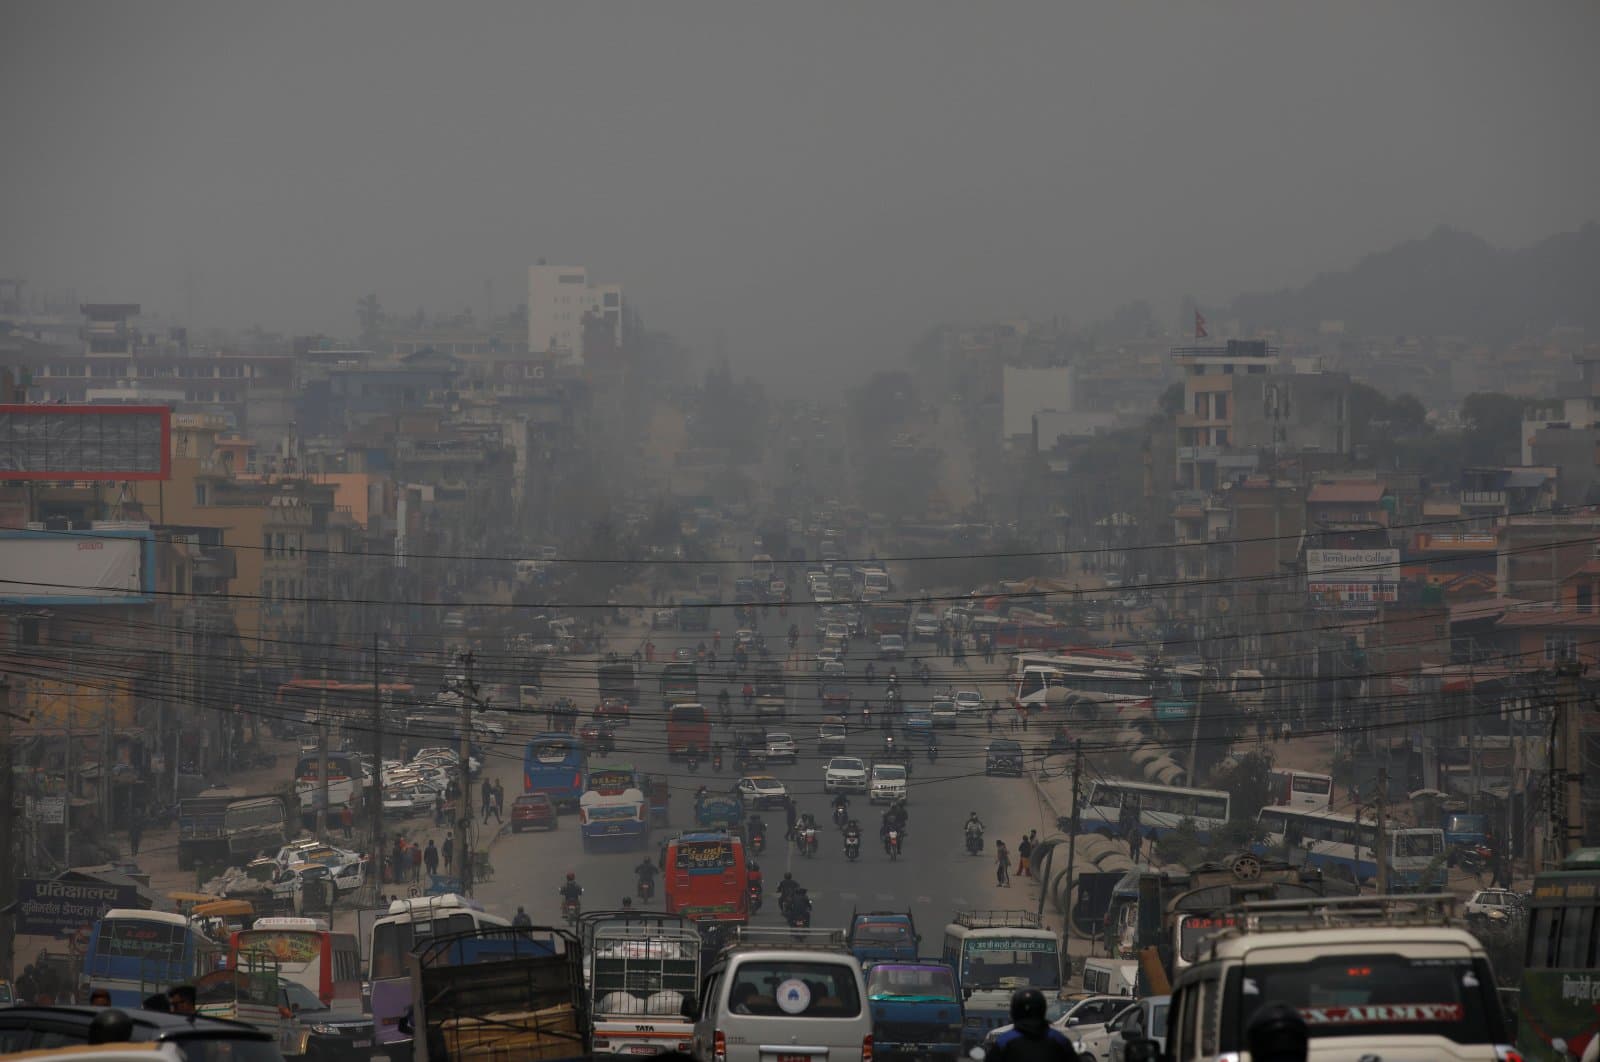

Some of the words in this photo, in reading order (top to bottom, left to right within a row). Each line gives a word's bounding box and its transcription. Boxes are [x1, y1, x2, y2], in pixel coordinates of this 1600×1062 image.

[524, 366, 545, 378] LG
[1365, 551, 1393, 564] College
[35, 882, 120, 900] प्रतिक्षालय
